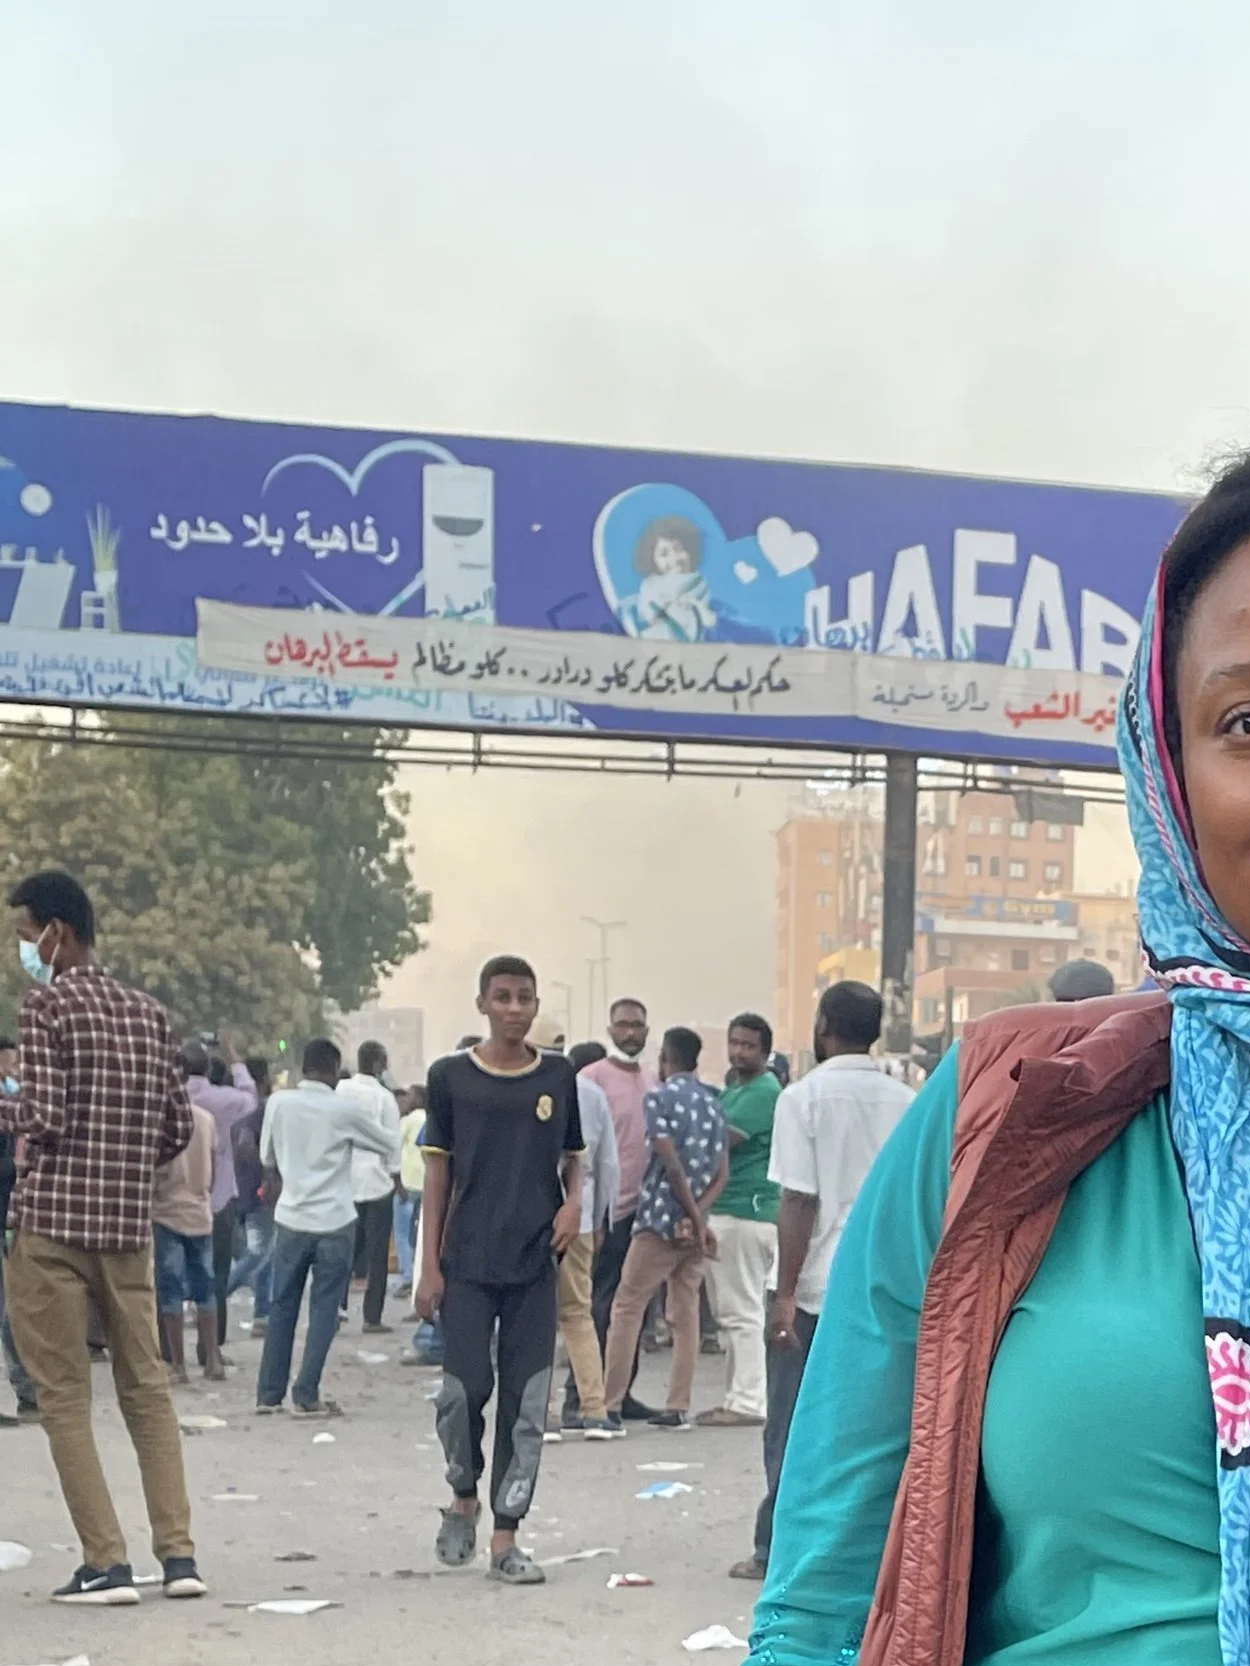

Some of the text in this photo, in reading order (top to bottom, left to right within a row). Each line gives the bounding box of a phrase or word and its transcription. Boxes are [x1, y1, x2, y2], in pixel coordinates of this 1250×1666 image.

[149, 509, 400, 565] رفاهية بلا حدود
